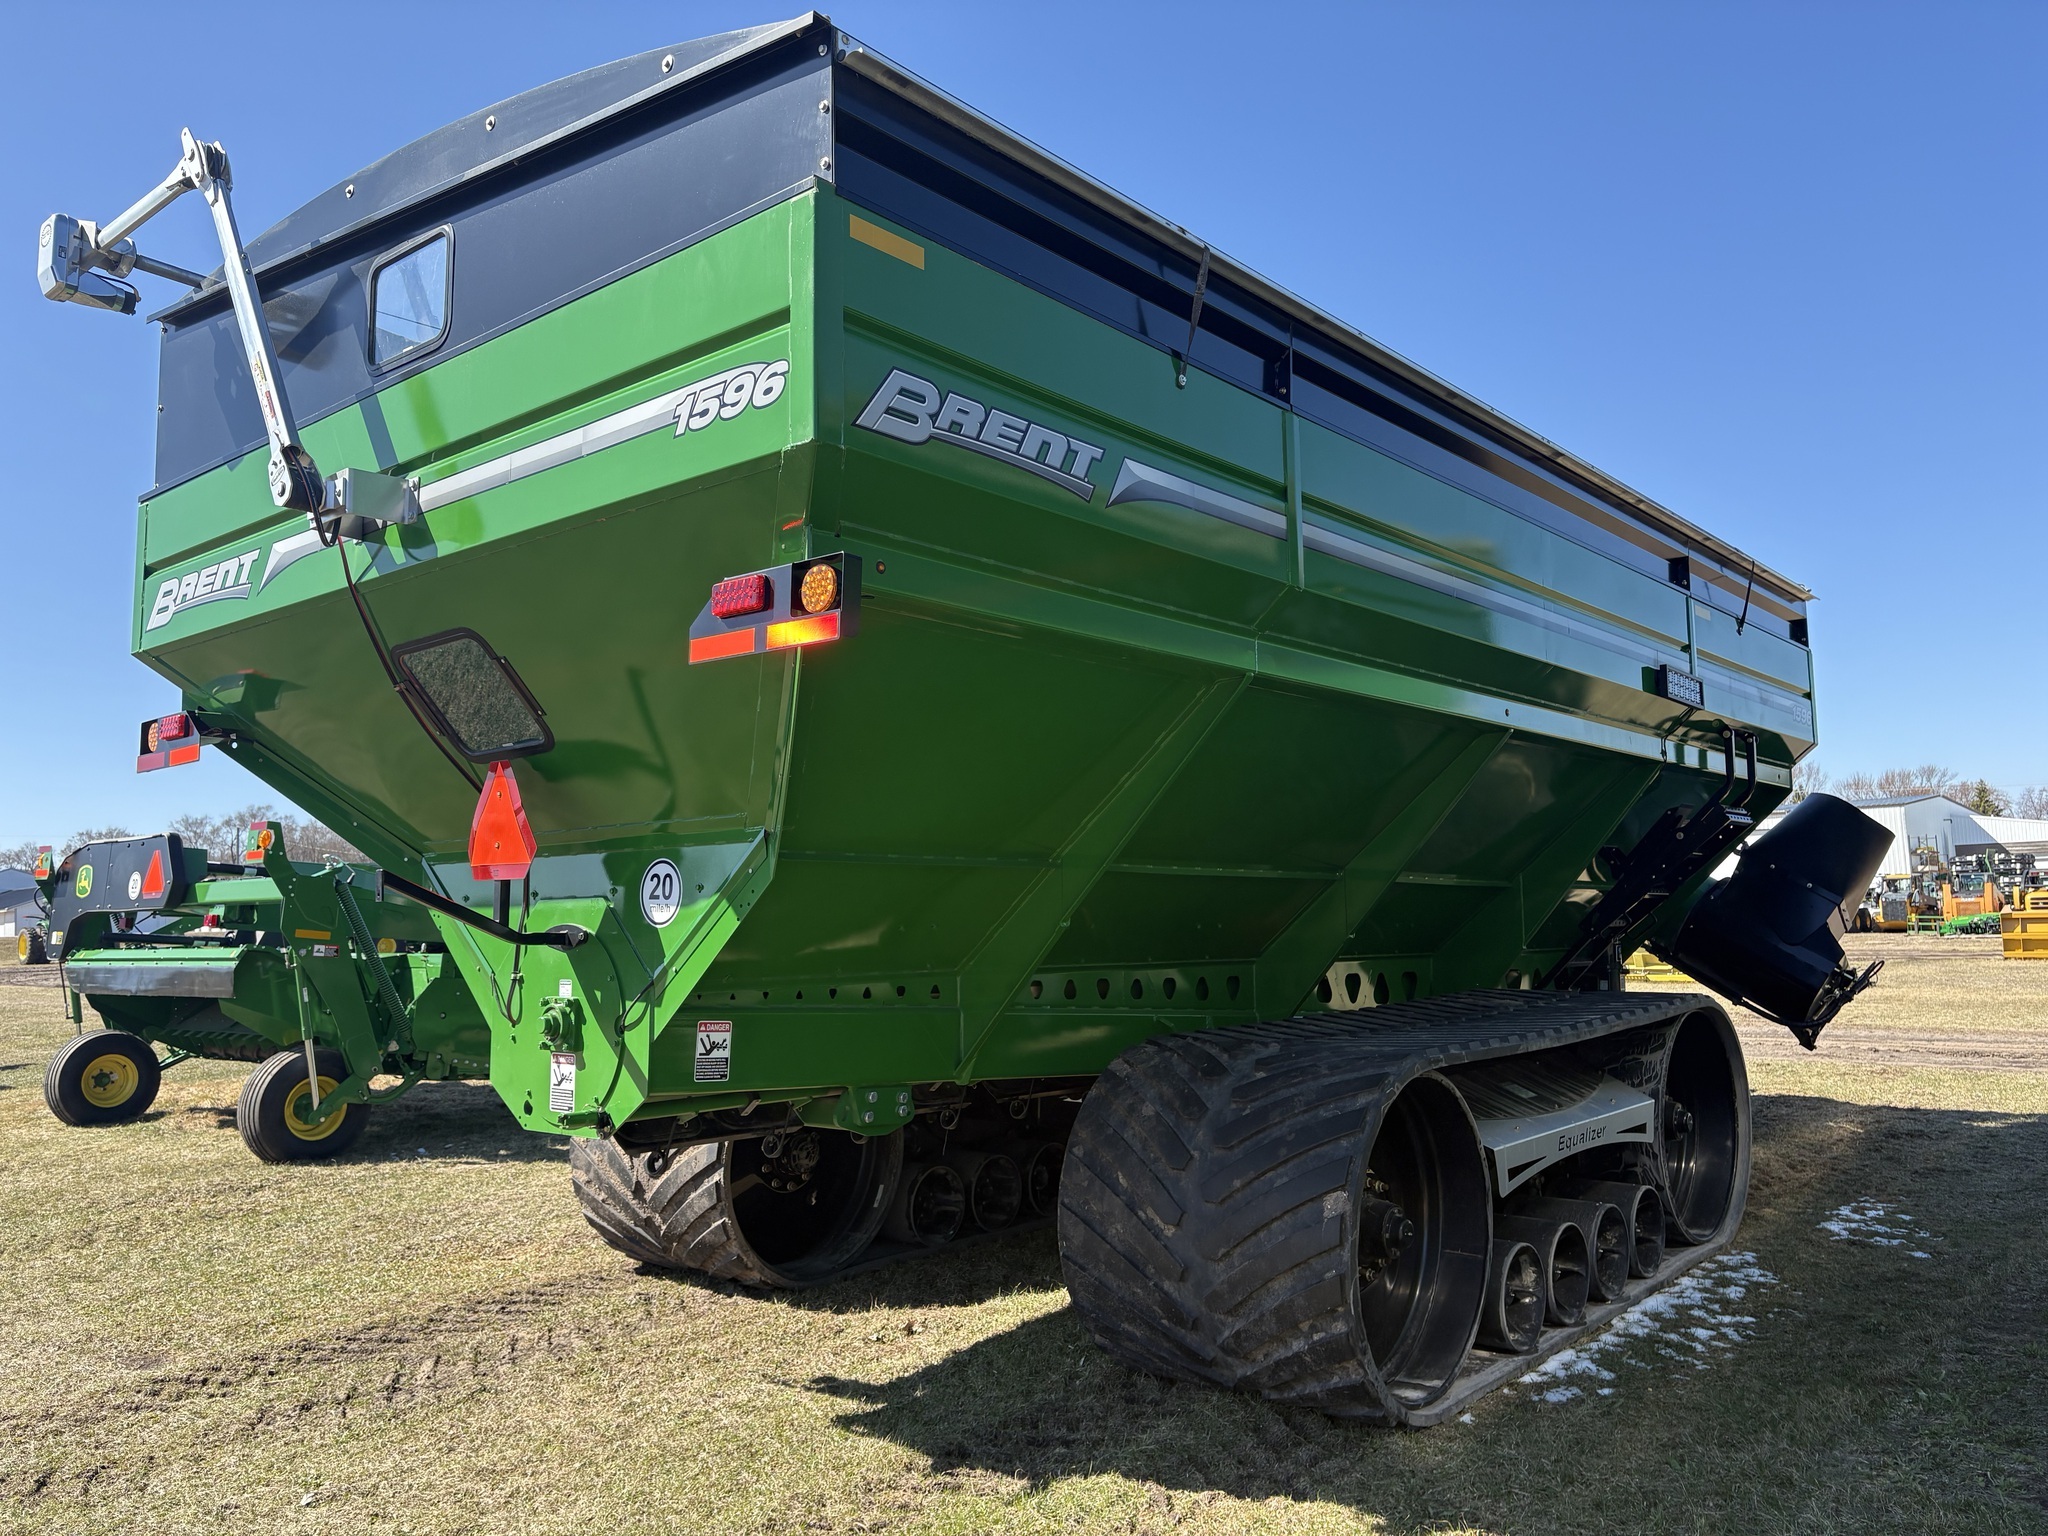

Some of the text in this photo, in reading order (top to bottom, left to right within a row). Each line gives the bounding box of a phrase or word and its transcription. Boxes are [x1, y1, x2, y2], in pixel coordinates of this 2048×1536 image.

[673, 359, 790, 439] 1596
[852, 366, 1106, 487] BRENT
[145, 547, 262, 633] BRENT
[1792, 704, 1812, 727] 1596
[649, 873, 673, 900] 20
[706, 1023, 730, 1031] DANGER
[1558, 1126, 1607, 1151] Equalizer
